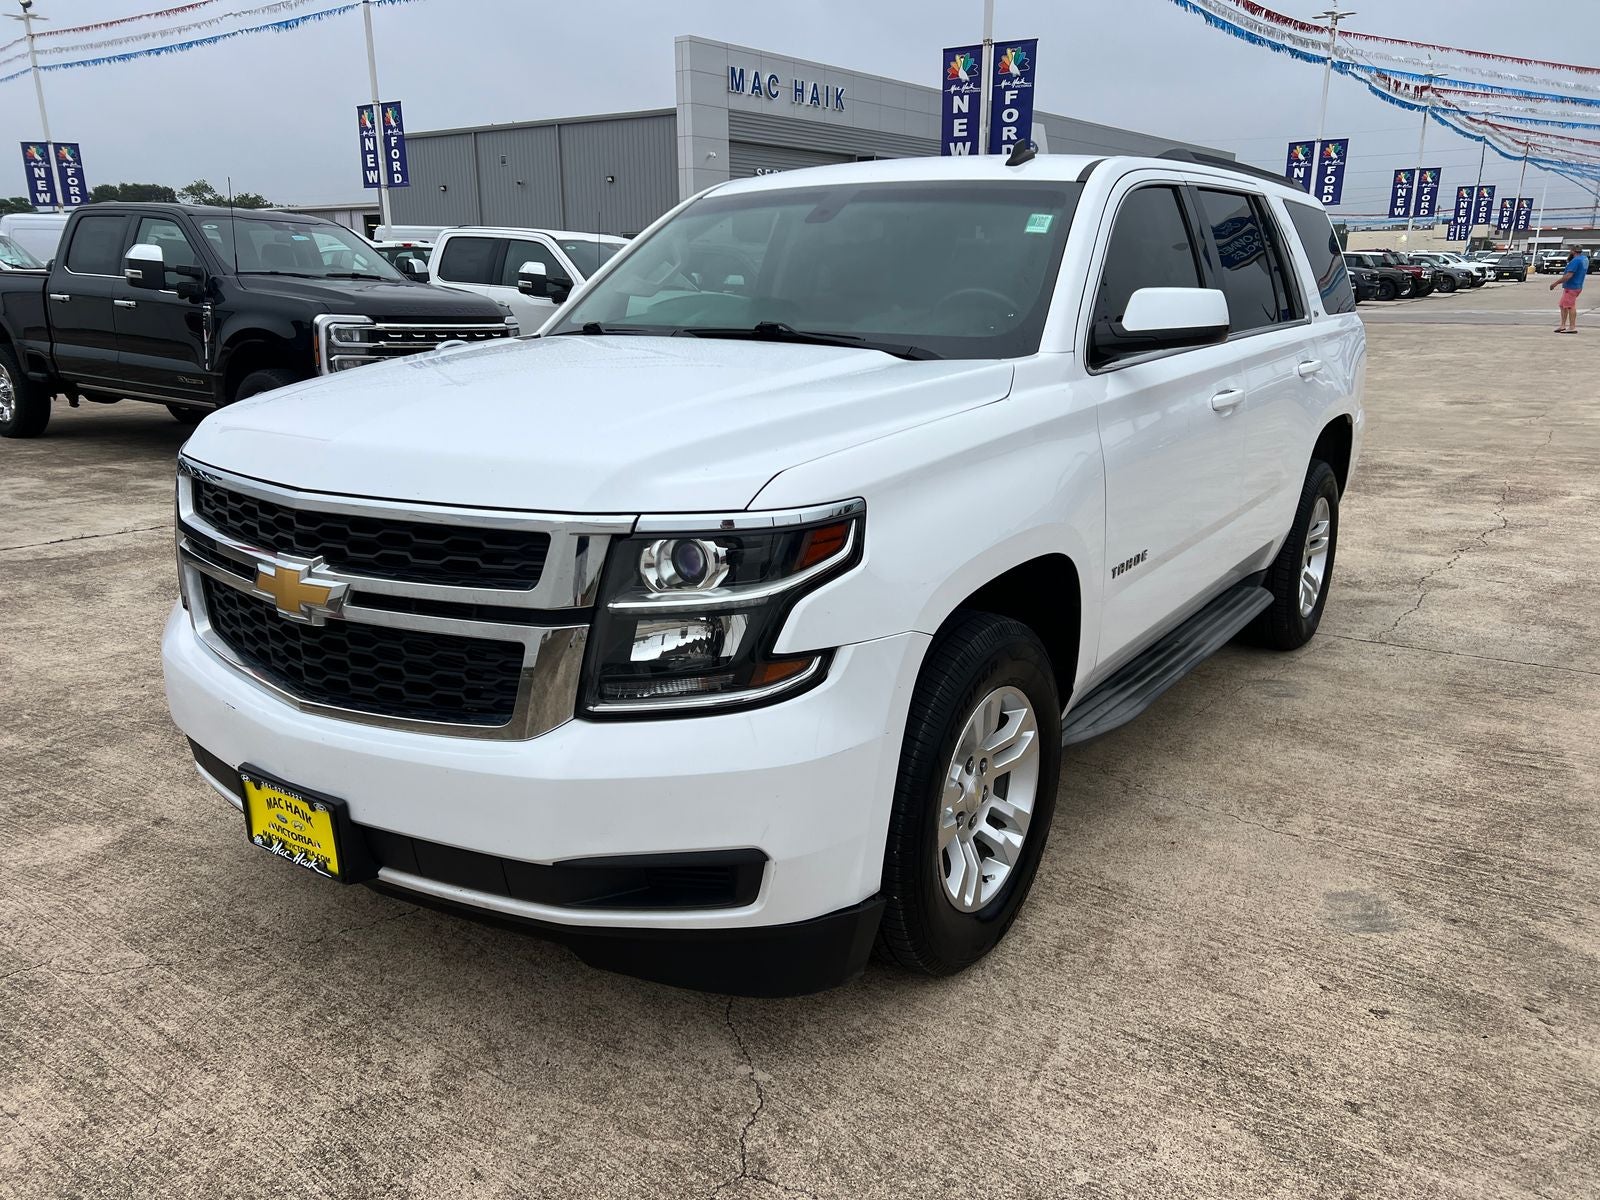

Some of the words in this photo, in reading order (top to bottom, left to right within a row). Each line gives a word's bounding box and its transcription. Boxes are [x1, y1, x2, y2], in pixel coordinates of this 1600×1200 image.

[729, 65, 779, 100] MAC
[793, 79, 845, 112] HAIK
[949, 94, 971, 156] NEW
[1001, 90, 1019, 155] FORD
[364, 137, 378, 183] NEW
[390, 136, 402, 183] FORD
[33, 167, 51, 203] NEW
[66, 168, 81, 204] FORD
[1322, 166, 1336, 203] FORD
[1394, 188, 1406, 216] NEW
[1420, 187, 1431, 216] FORD
[1457, 201, 1467, 224] NEW
[1478, 201, 1487, 223] FORD
[1500, 210, 1509, 229] NEW
[1518, 210, 1526, 229] FORD
[1111, 549, 1148, 579] TAHOE
[266, 797, 284, 811] MAC
[284, 800, 315, 830] HAIK
[270, 840, 290, 856] Mac
[293, 852, 322, 872] Haik
